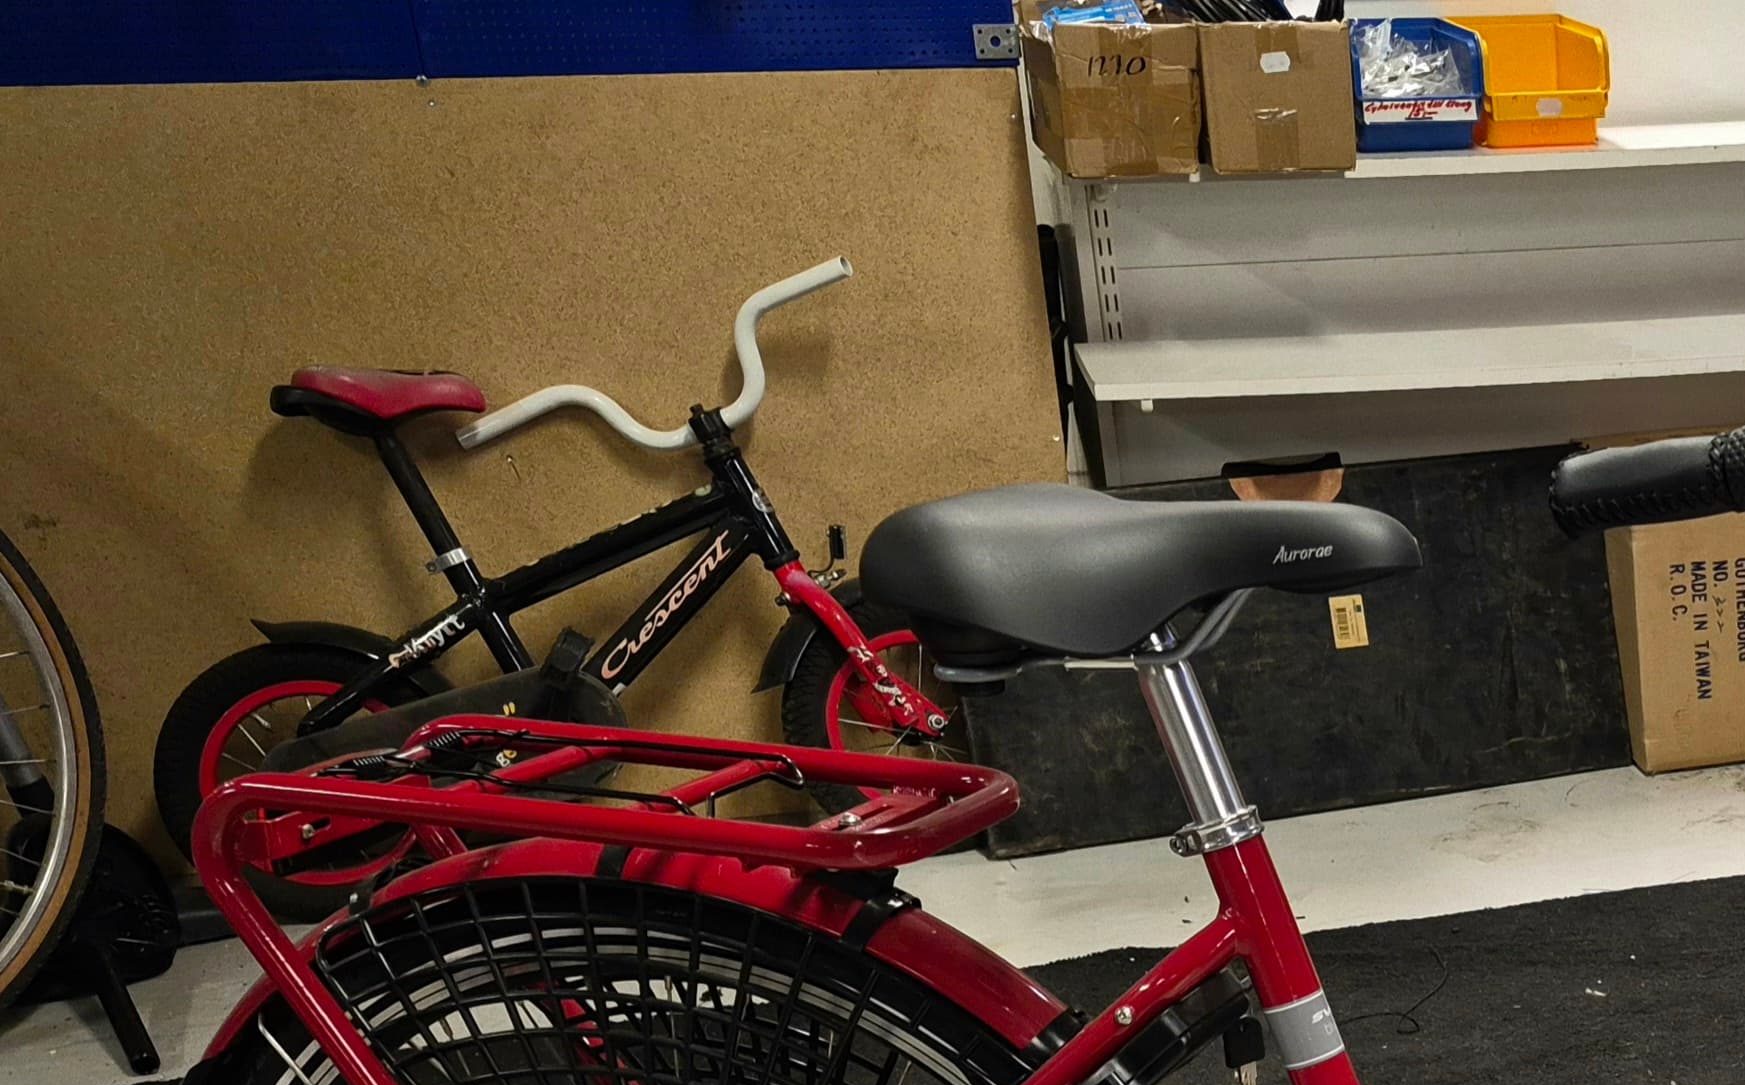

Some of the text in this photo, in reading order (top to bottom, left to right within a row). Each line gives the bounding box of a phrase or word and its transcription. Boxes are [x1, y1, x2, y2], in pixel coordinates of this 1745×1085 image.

[1272, 544, 1334, 565] Aurorae
[1712, 560, 1729, 588] NO.
[601, 529, 732, 680] Crescent
[1691, 561, 1712, 700] MADE IN TAIWAN
